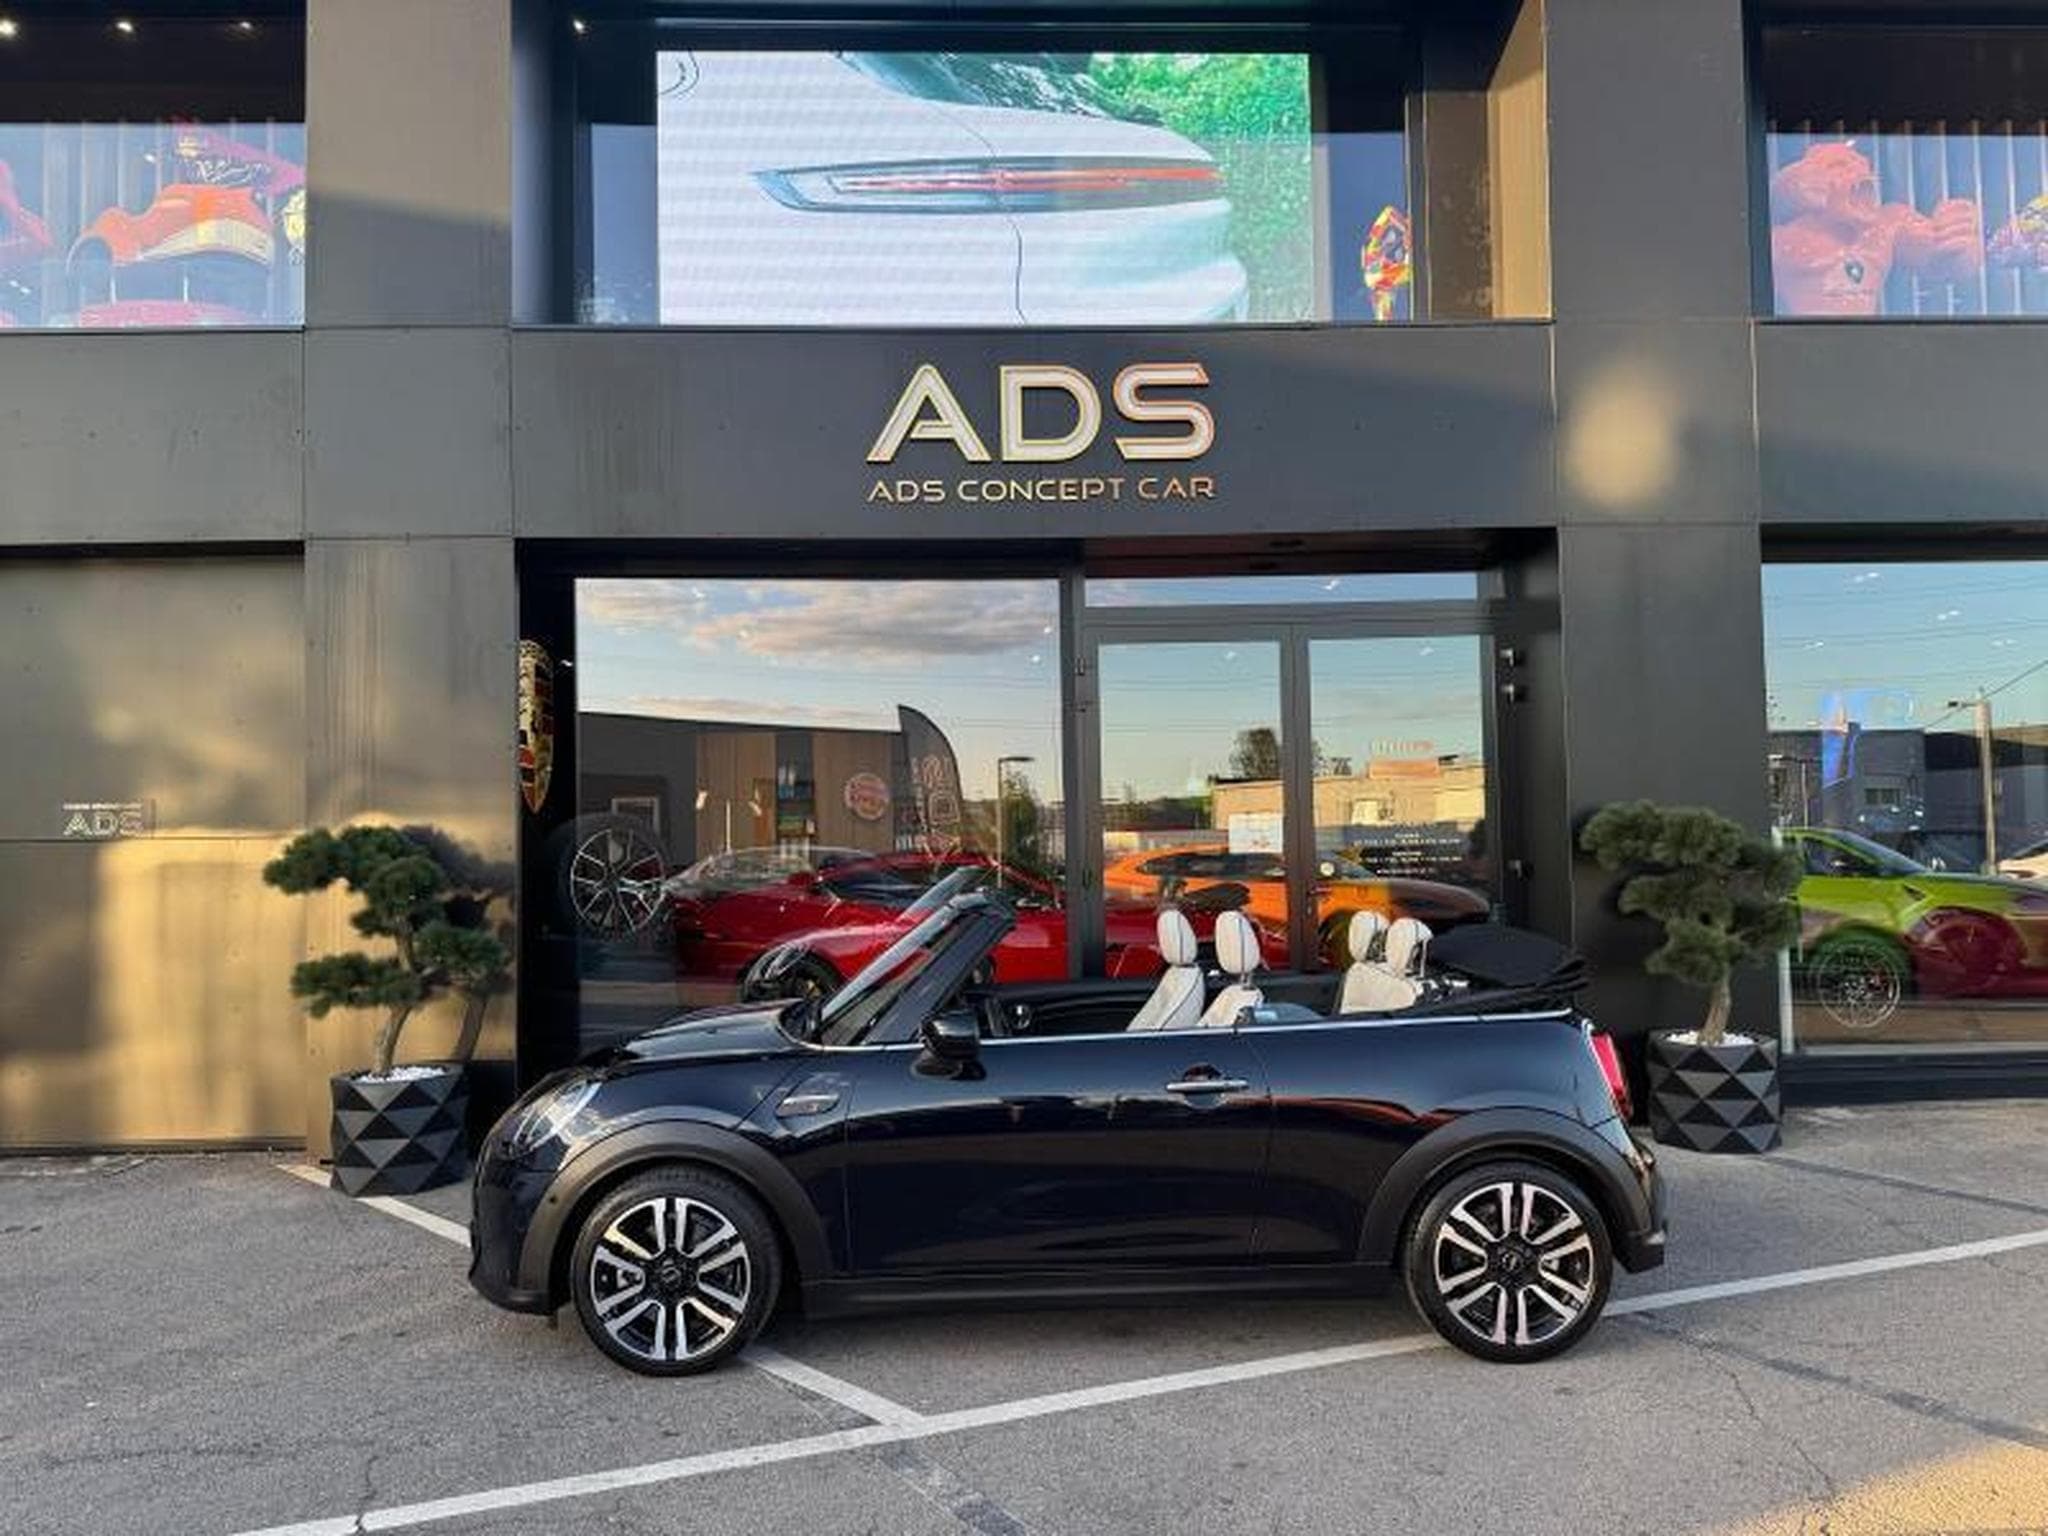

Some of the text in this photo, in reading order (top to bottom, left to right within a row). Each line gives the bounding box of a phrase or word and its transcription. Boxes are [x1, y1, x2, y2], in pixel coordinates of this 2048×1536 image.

[866, 363, 1215, 461] ADS
[868, 476, 1215, 502] ADS CONCEPT CAR
[63, 811, 143, 836] ADS
